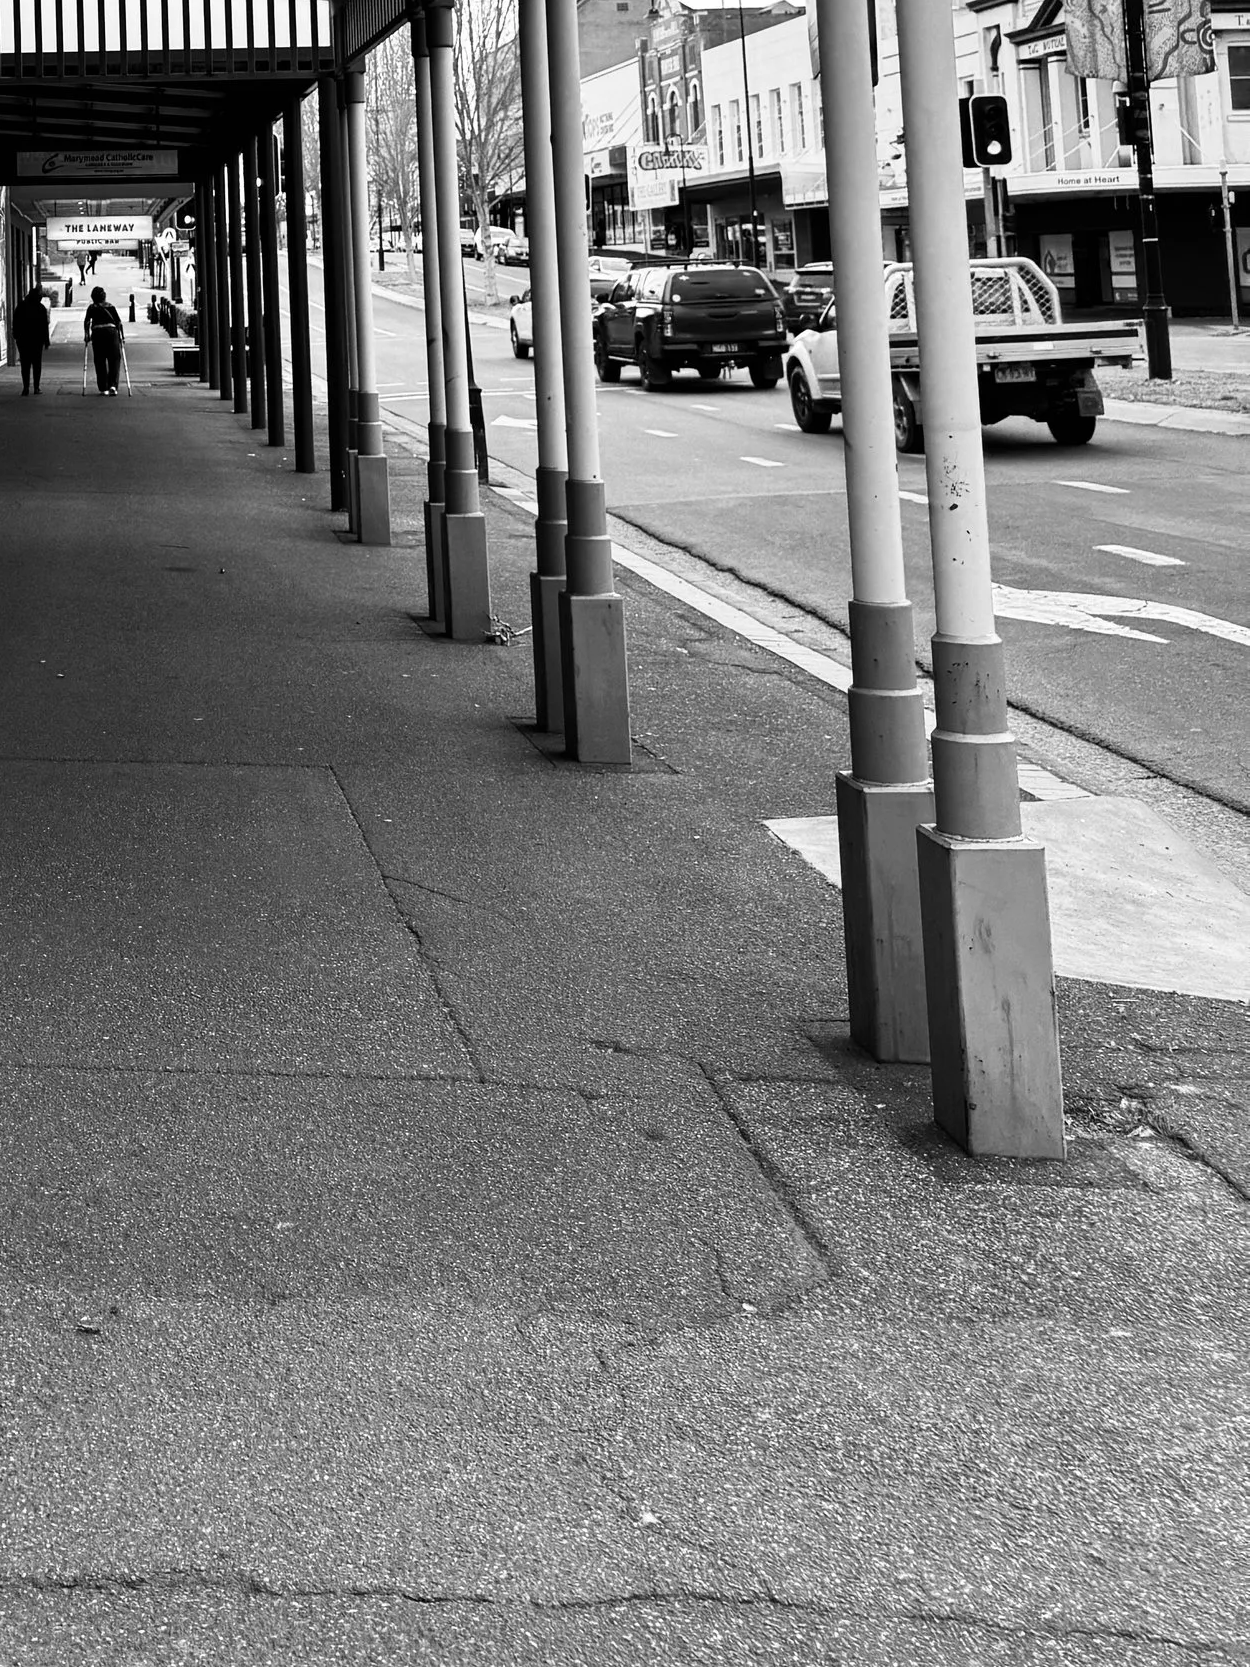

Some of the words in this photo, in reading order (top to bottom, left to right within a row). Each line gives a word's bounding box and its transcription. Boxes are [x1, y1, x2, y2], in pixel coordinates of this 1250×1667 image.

[1094, 175, 1120, 183] Heart
[65, 224, 84, 233] THE
[87, 223, 135, 232] LANEWAY
